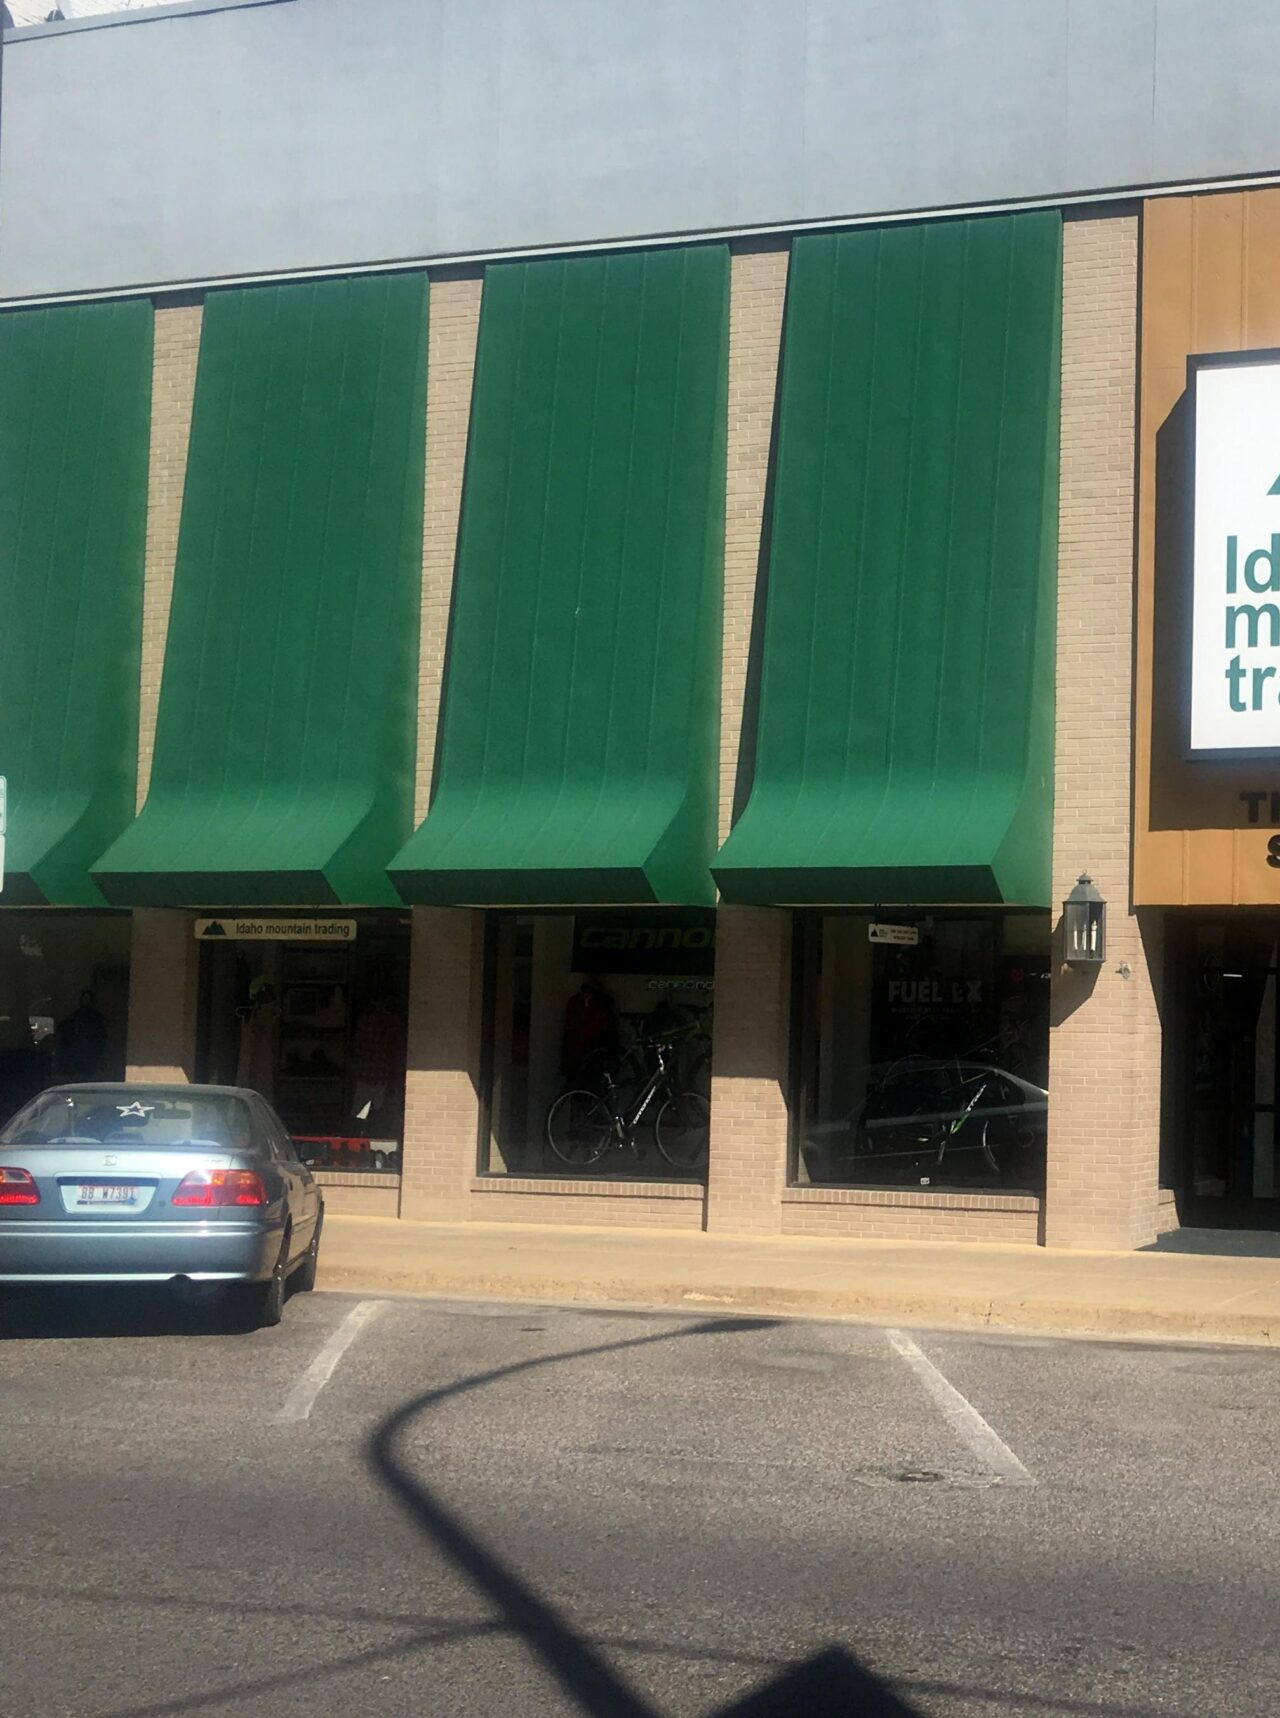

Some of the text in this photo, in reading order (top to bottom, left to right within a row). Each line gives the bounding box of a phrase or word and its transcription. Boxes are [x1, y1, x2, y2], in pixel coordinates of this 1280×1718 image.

[236, 921, 350, 938] Idaho mountain trading
[887, 979, 944, 1004] FUEL
